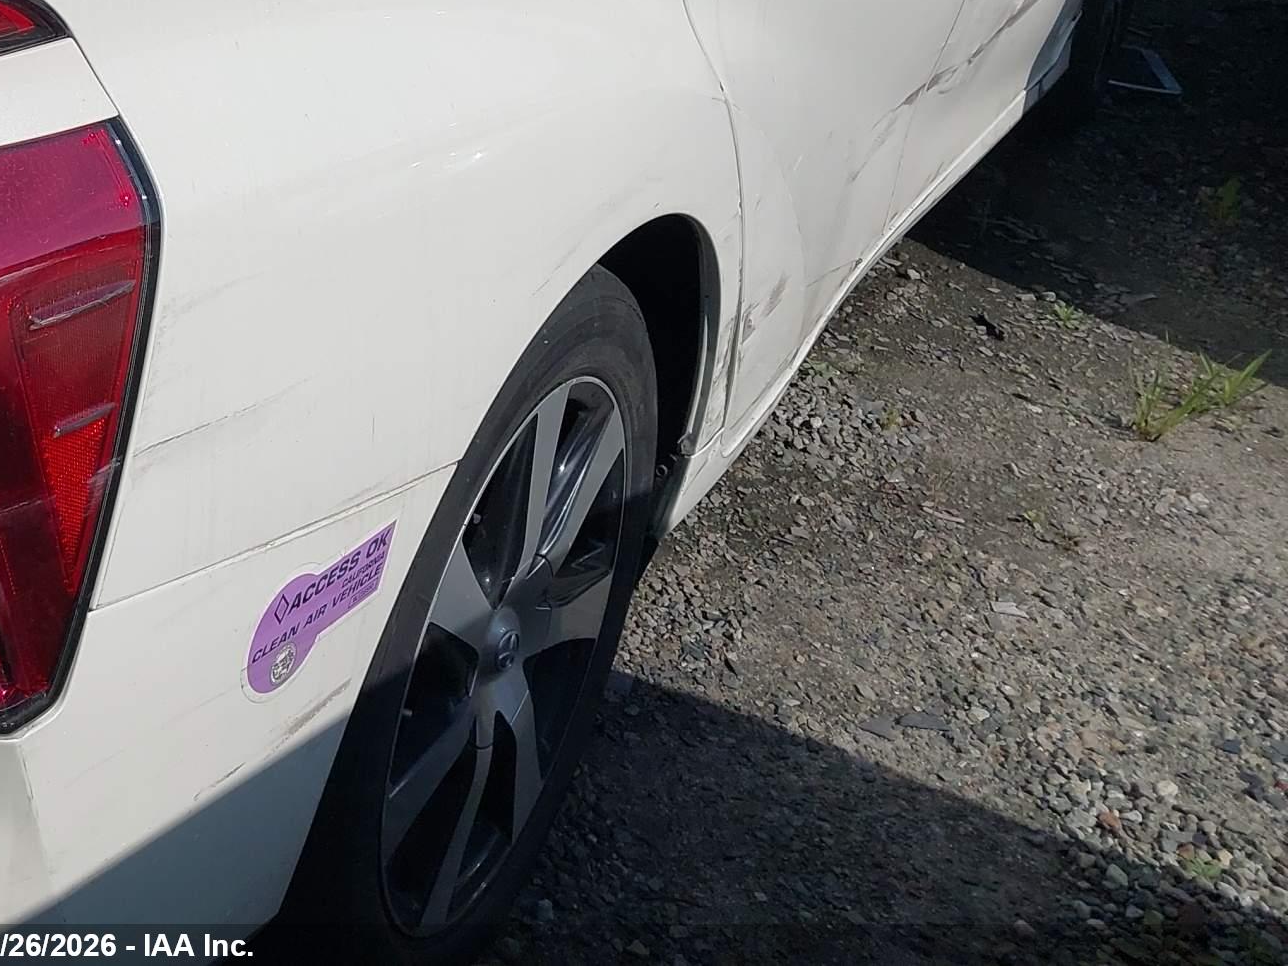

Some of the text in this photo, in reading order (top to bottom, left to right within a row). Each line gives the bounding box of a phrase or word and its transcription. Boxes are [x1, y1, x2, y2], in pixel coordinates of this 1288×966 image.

[287, 551, 361, 615] ACCESS
[366, 530, 390, 559] OK
[342, 551, 385, 589] CALIFORNIA
[251, 621, 301, 664] CLEAN
[303, 603, 328, 630] AIR
[331, 563, 383, 607] VEHICLE
